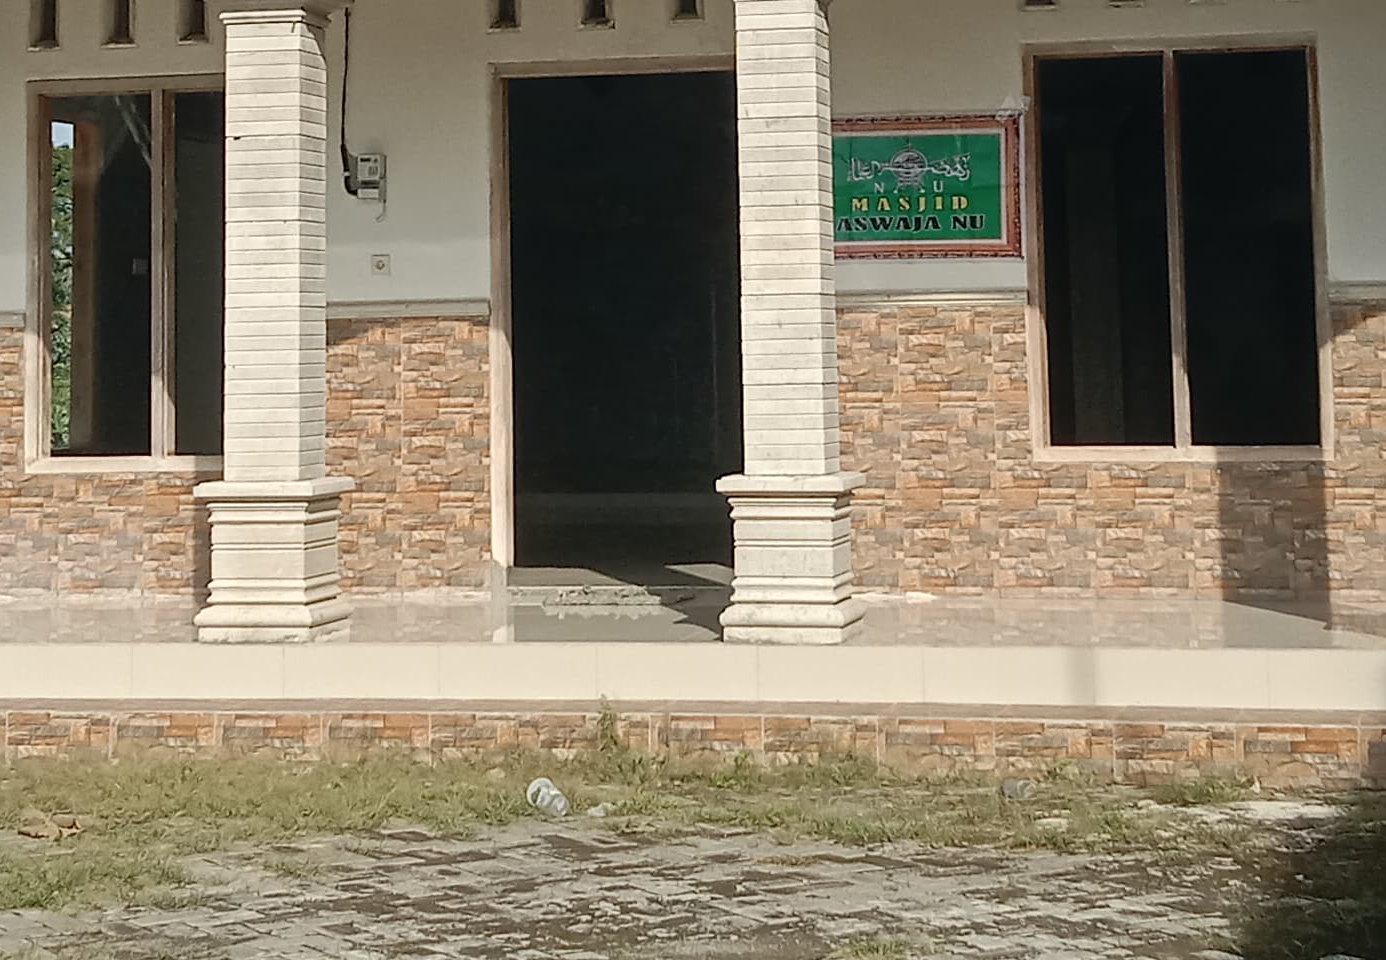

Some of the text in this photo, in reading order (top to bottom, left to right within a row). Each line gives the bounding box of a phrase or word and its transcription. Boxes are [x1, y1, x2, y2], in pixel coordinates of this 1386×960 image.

[851, 195, 969, 213] MASJID
[836, 214, 986, 234] ASWAJA NU
